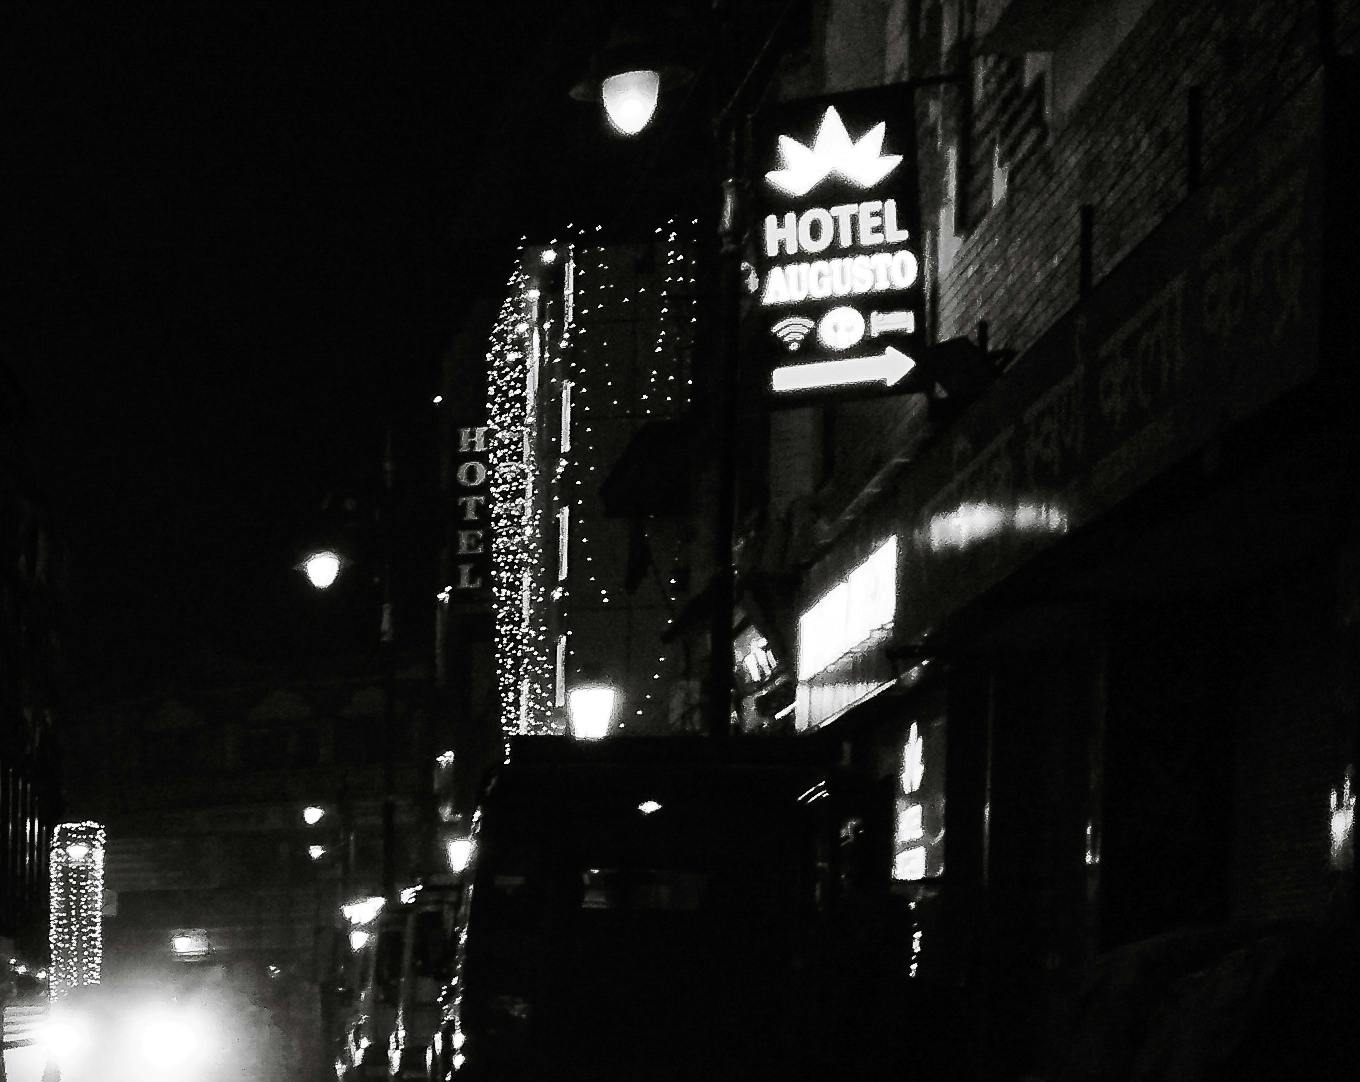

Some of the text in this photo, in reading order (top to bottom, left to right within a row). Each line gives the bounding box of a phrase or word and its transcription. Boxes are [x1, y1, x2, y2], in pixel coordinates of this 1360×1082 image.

[765, 199, 909, 257] HOTEL
[762, 249, 918, 306] AUGUSTO
[457, 427, 488, 588] HOTEL
